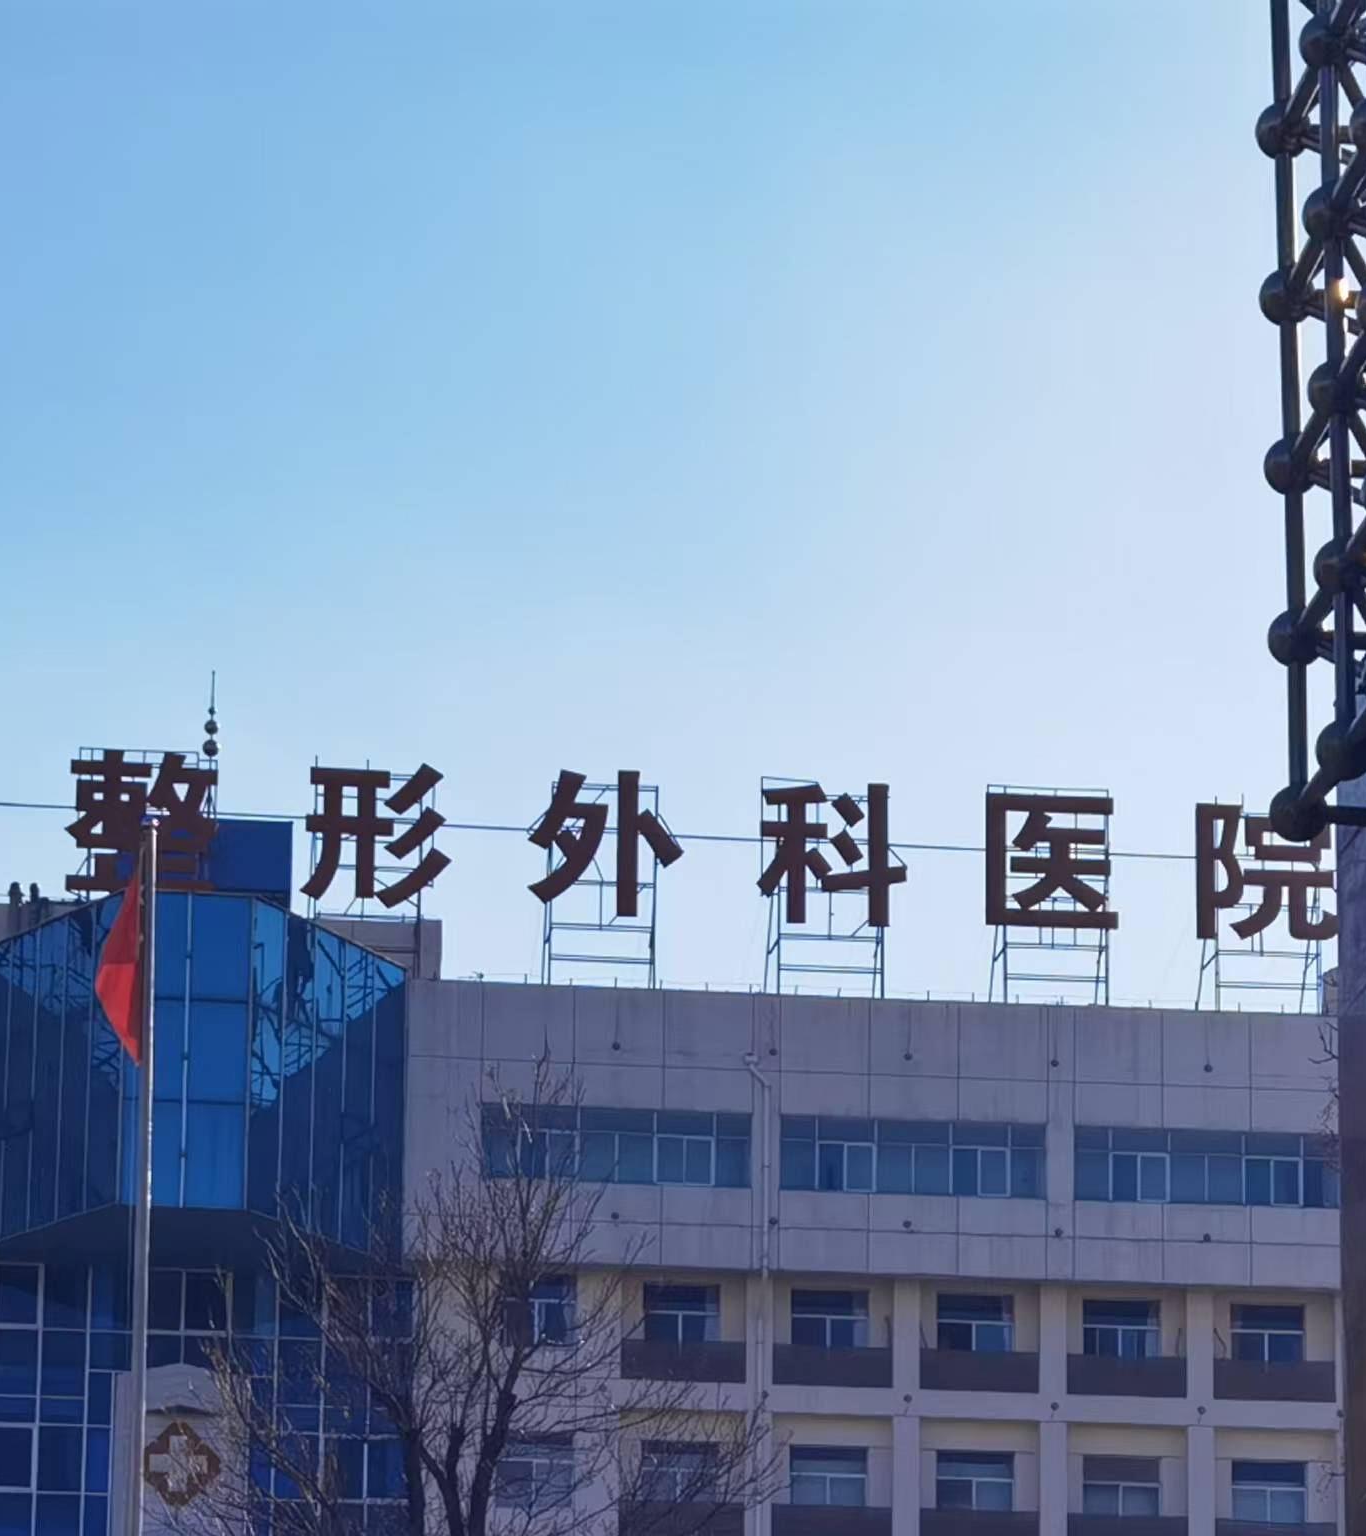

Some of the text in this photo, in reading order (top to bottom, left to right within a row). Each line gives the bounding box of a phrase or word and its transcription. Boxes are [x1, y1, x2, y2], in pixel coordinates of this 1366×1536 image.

[64, 750, 1339, 941] 整形外科医院
